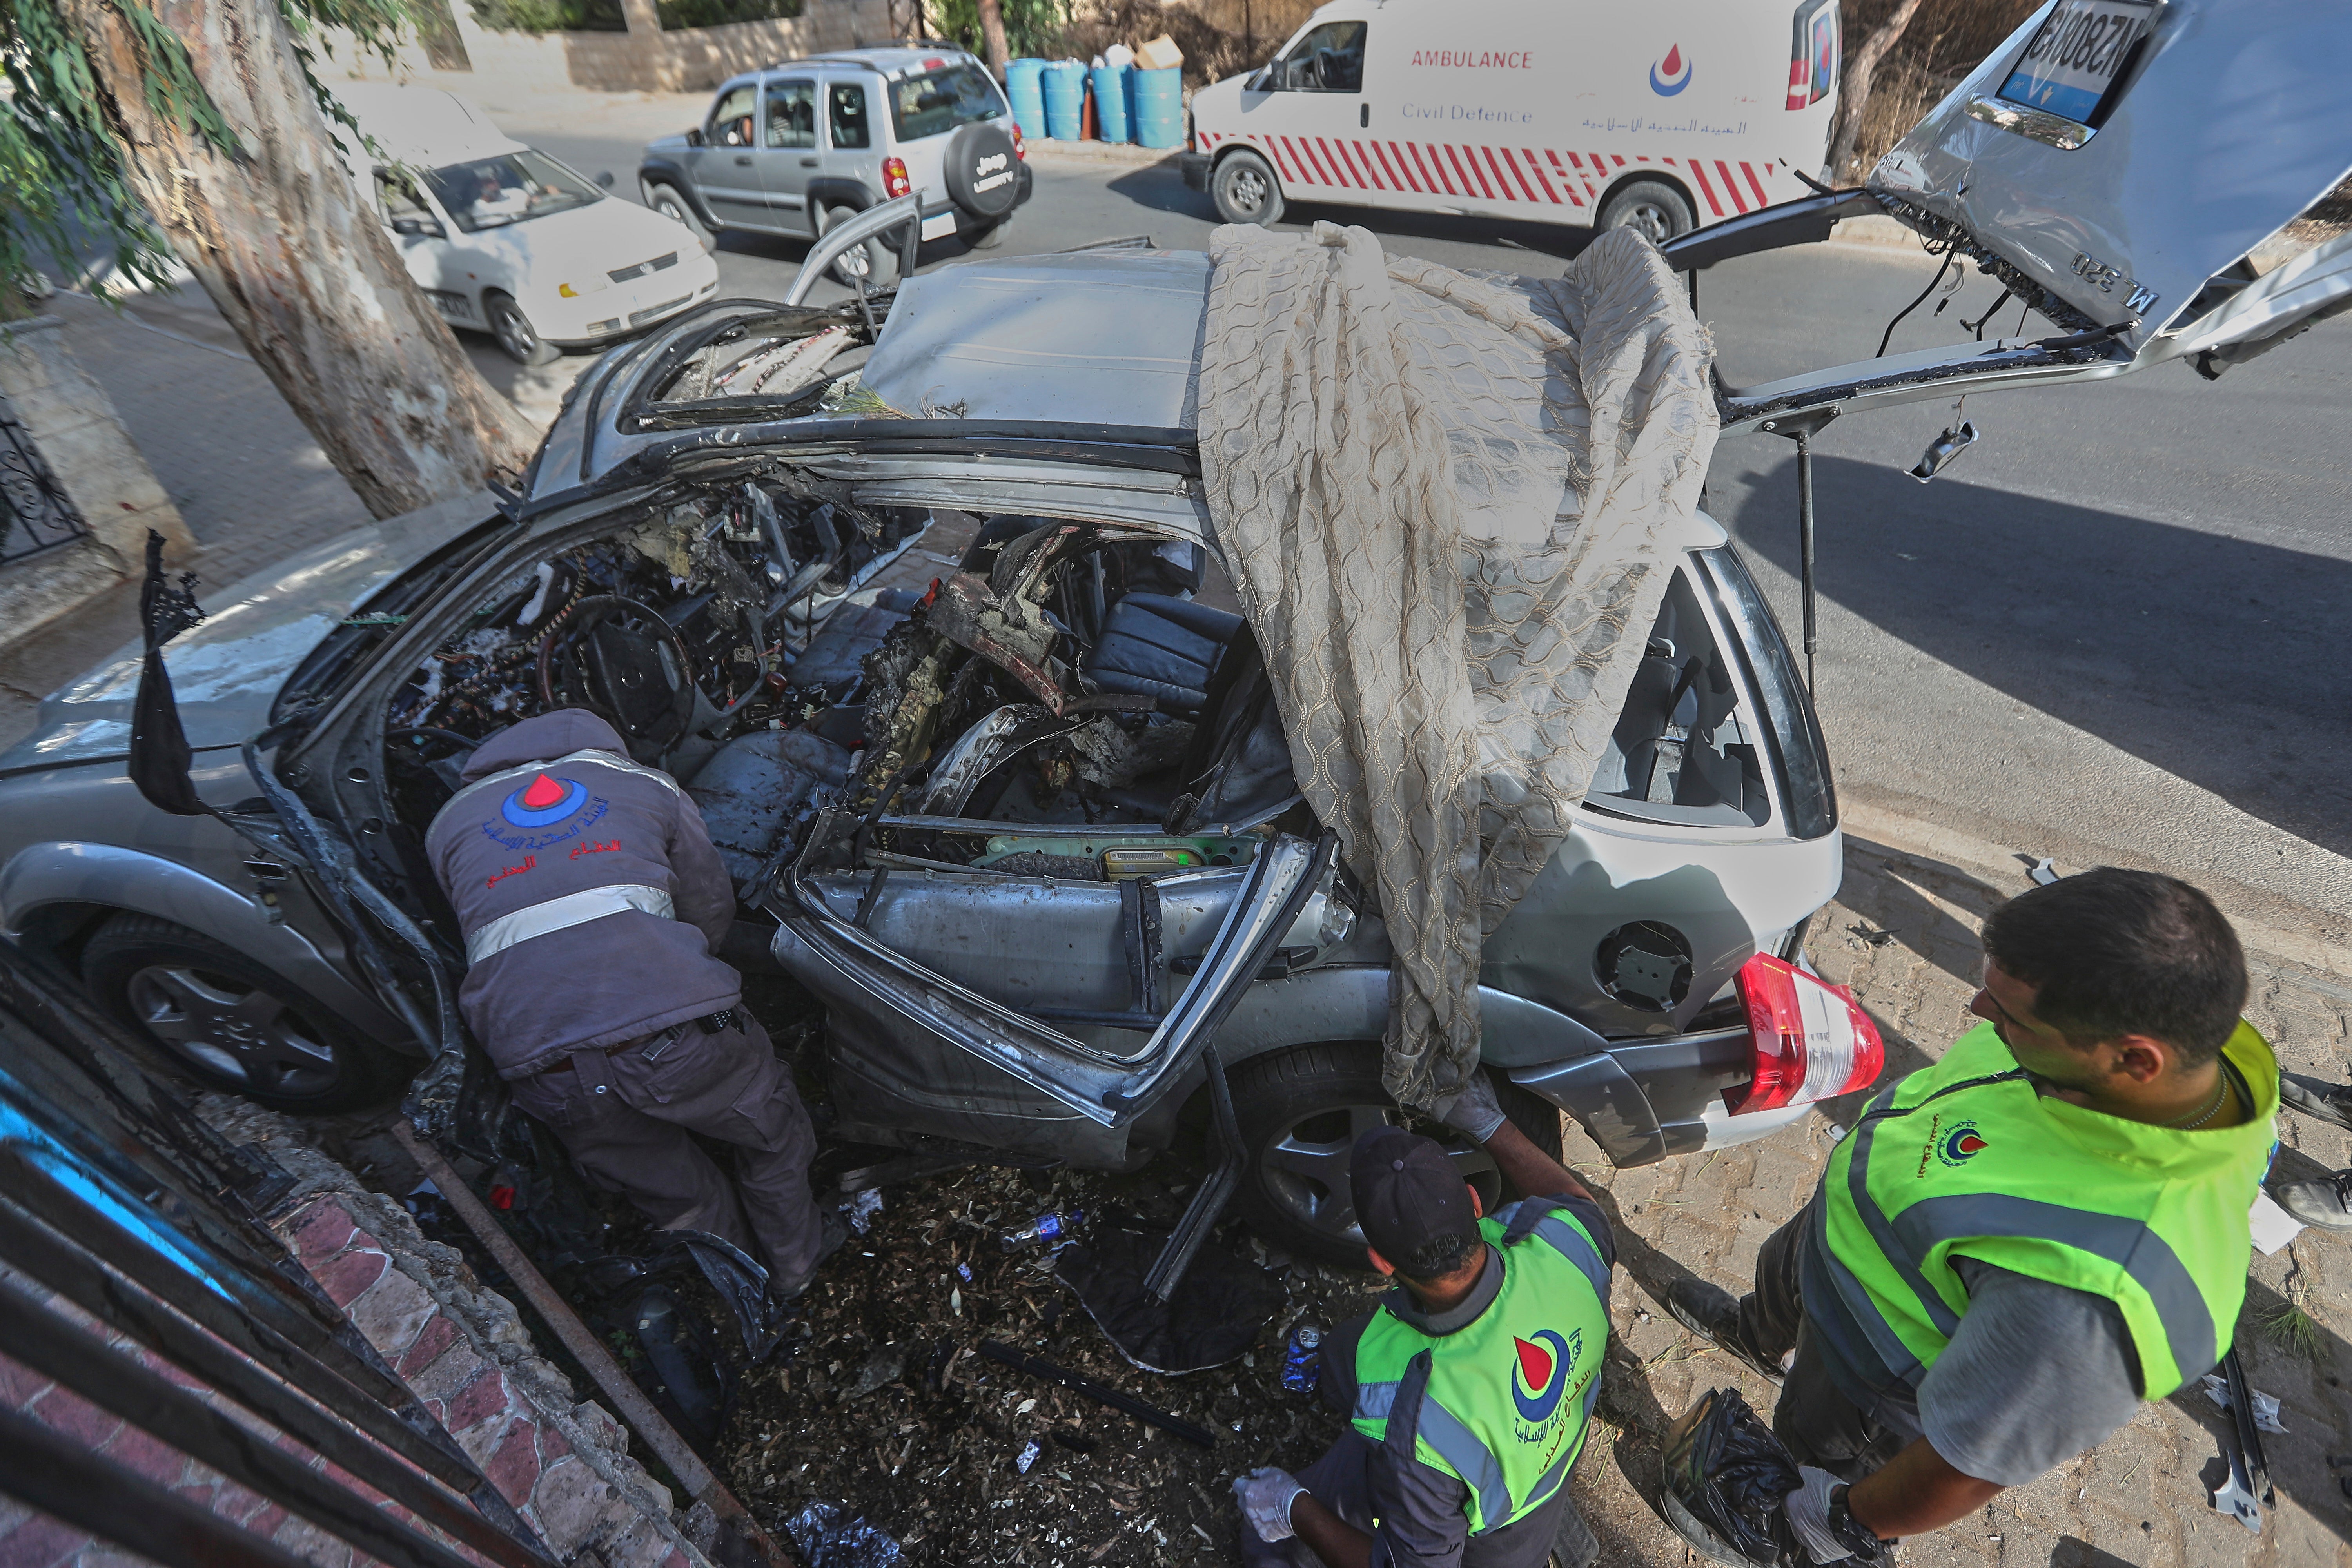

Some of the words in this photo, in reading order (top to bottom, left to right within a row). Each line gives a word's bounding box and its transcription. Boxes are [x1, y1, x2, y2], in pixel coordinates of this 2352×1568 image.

[1412, 50, 1534, 69] AMBULANCE
[1402, 102, 1443, 119] Civil
[1451, 104, 1532, 123] Defence
[2070, 250, 2121, 294] 320
[2119, 278, 2159, 316] ML
[569, 839, 621, 860] الدفاع
